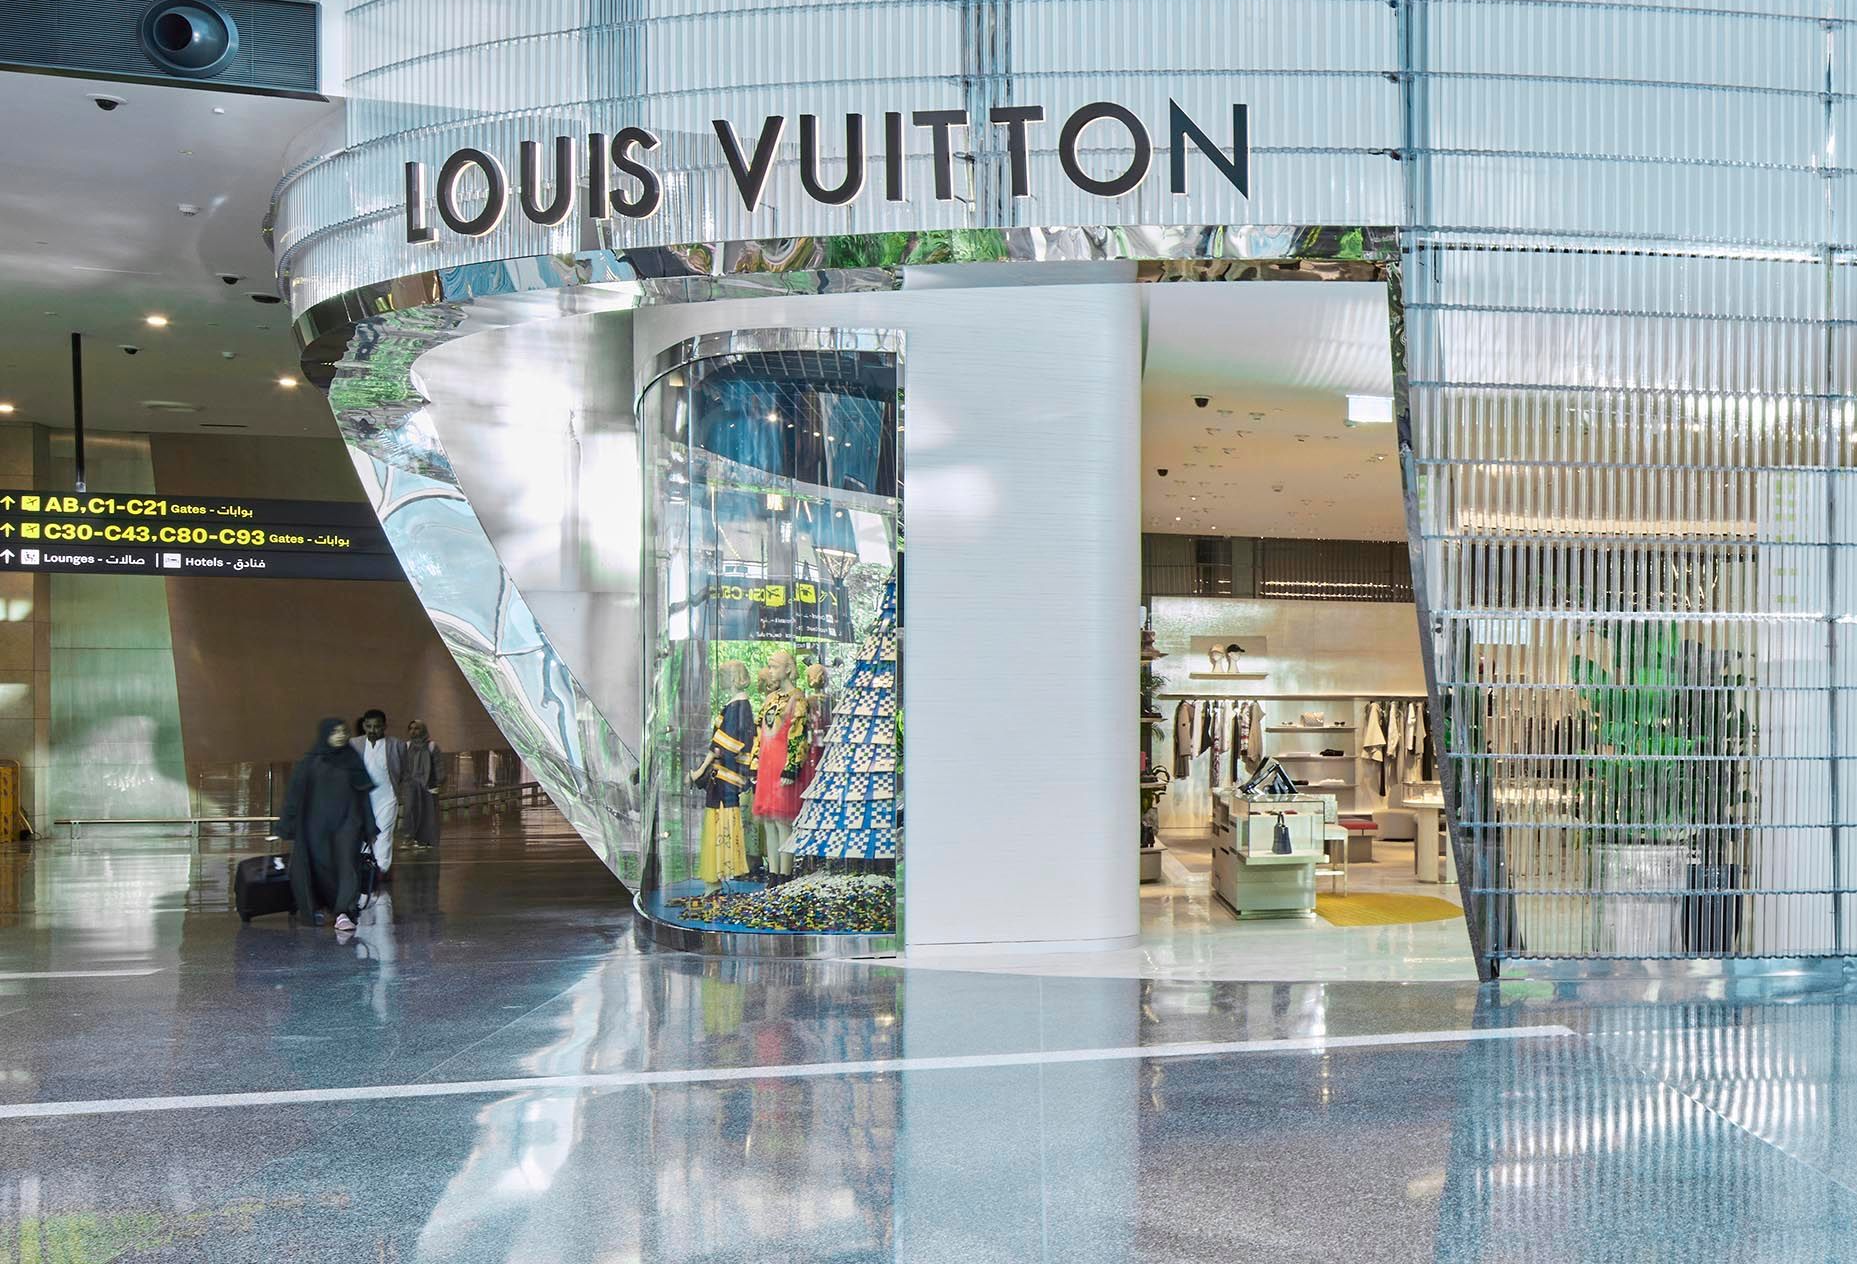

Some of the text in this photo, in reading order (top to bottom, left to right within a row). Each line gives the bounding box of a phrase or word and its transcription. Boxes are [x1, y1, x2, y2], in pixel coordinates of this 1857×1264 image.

[405, 97, 1249, 245] LOUIS VUITTON
[170, 504, 207, 515] Gates
[216, 506, 253, 518] بوابات
[268, 534, 305, 545] Gates
[314, 535, 350, 548] بوابات
[44, 553, 95, 566] Lounges
[105, 554, 146, 565] صالات
[185, 557, 224, 568] Hotels
[232, 558, 266, 571] فنادق
